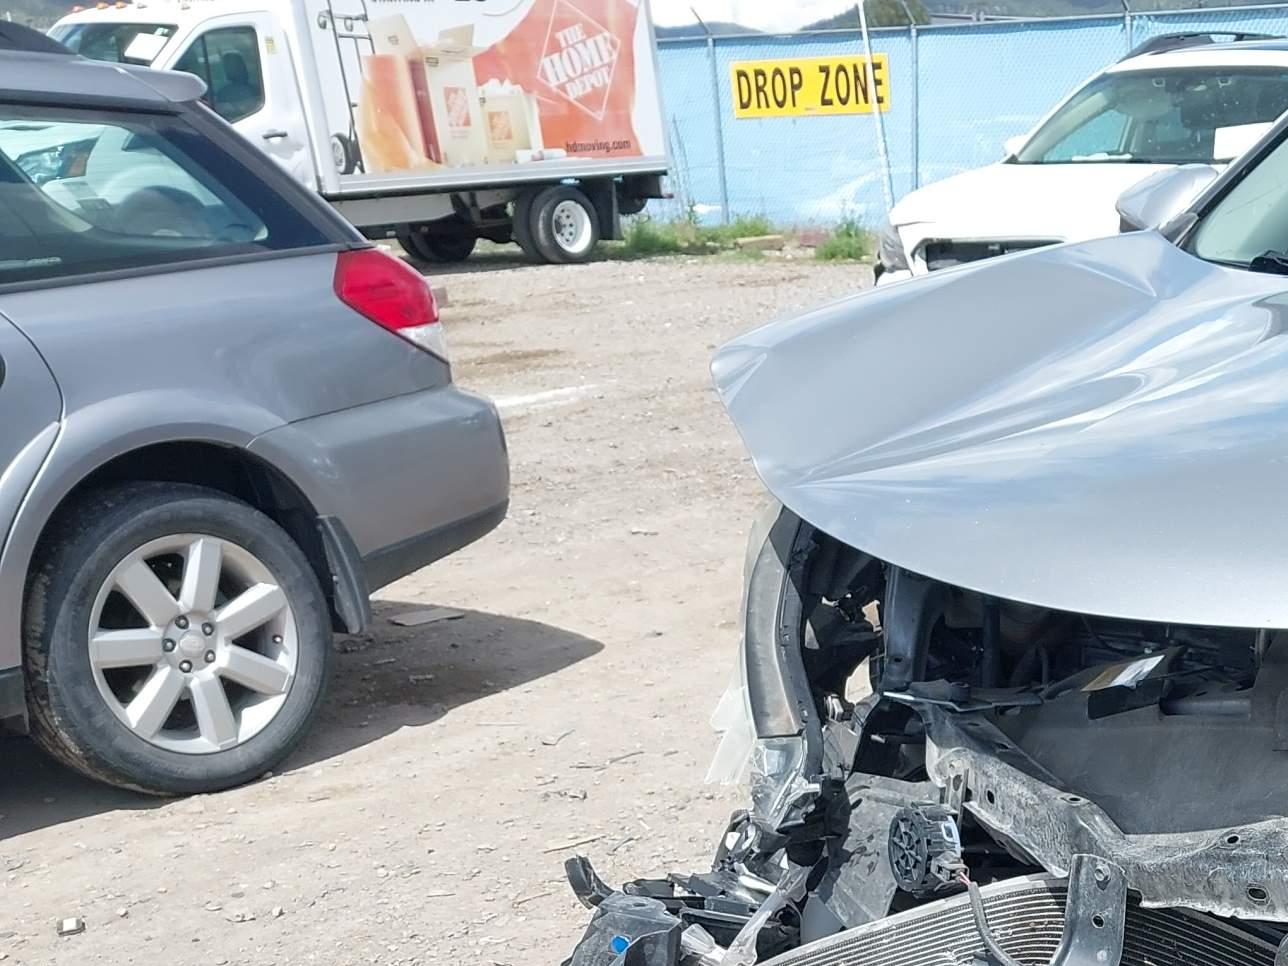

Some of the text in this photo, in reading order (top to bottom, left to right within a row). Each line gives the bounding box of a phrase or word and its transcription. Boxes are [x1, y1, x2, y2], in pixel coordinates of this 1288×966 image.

[554, 23, 586, 49] THE
[542, 31, 616, 87] HOME
[565, 65, 610, 98] DEPOT
[736, 62, 884, 110] DROP ZONE
